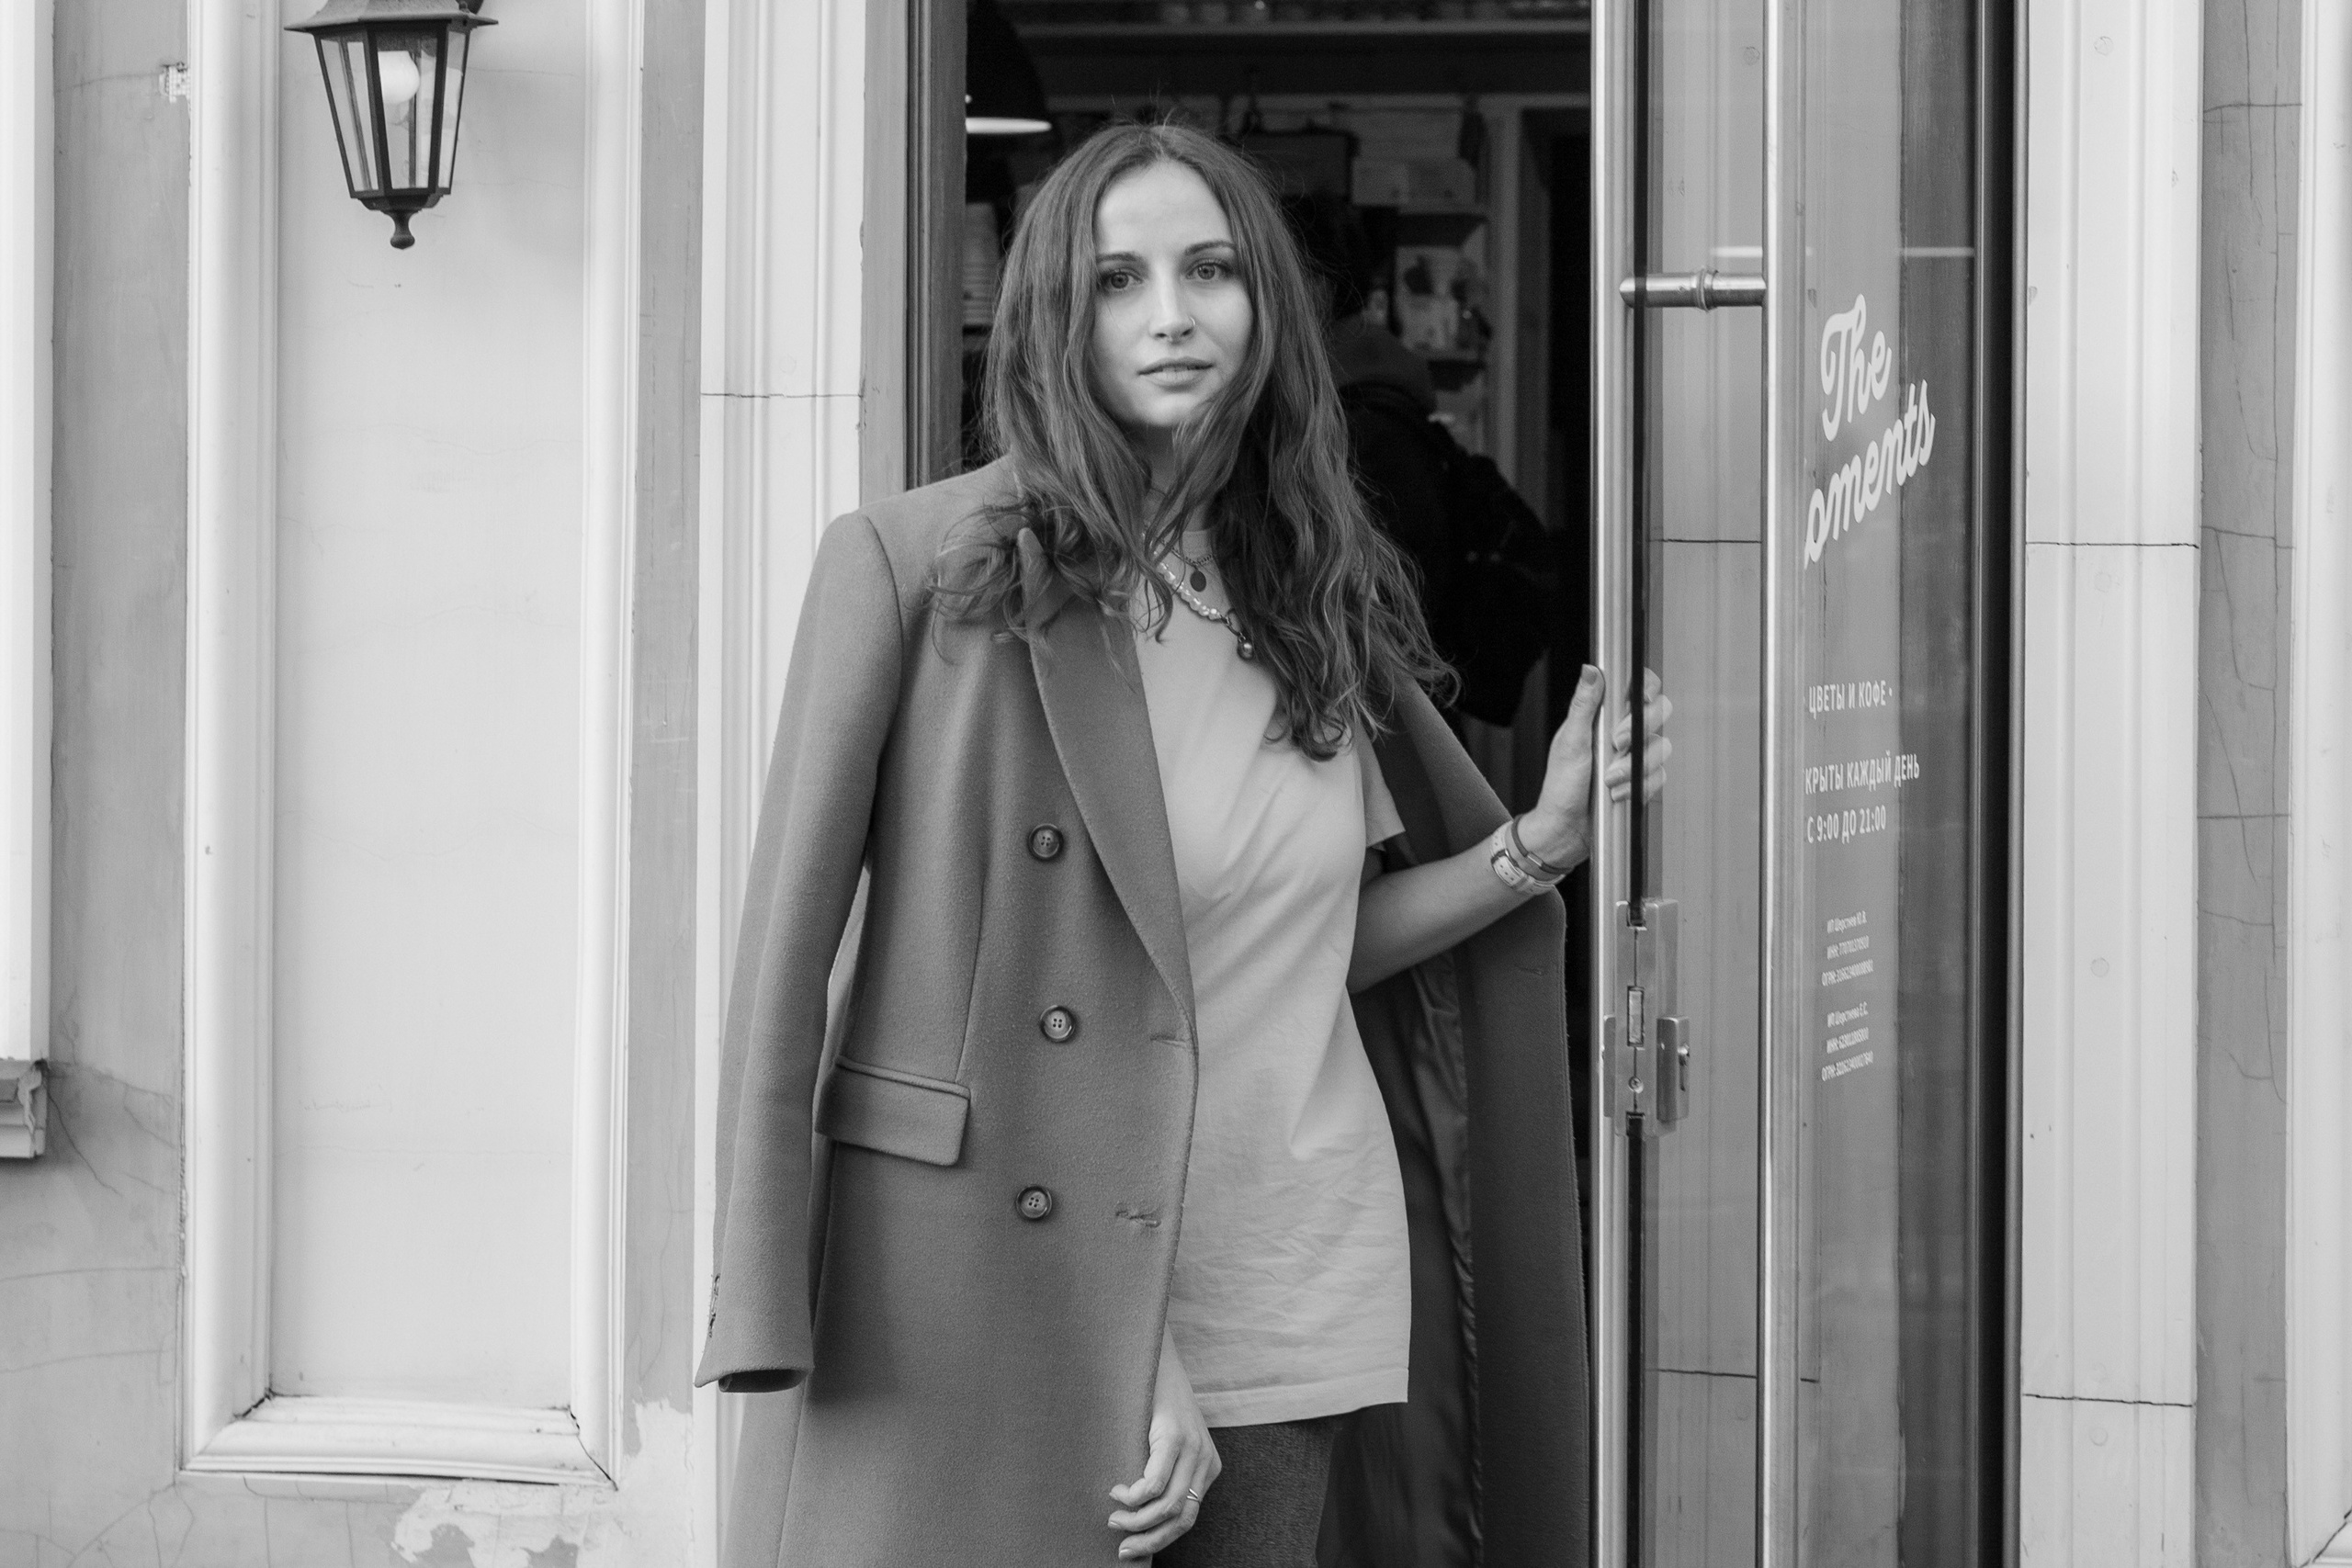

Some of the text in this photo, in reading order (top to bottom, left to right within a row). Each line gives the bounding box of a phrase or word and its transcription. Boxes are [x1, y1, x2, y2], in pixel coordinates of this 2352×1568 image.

[1821, 293, 1892, 441] The
[1804, 378, 1936, 570] oments
[1809, 680, 1886, 720] ЦВЕТЫ И КОФЕ
[1805, 750, 1920, 795] КРЫТЫ КАЖДЫЙ ДЕНЬ
[1817, 812, 1839, 842] 9:00
[1842, 809, 1857, 844] ДО
[1860, 805, 1886, 835] 21:00
